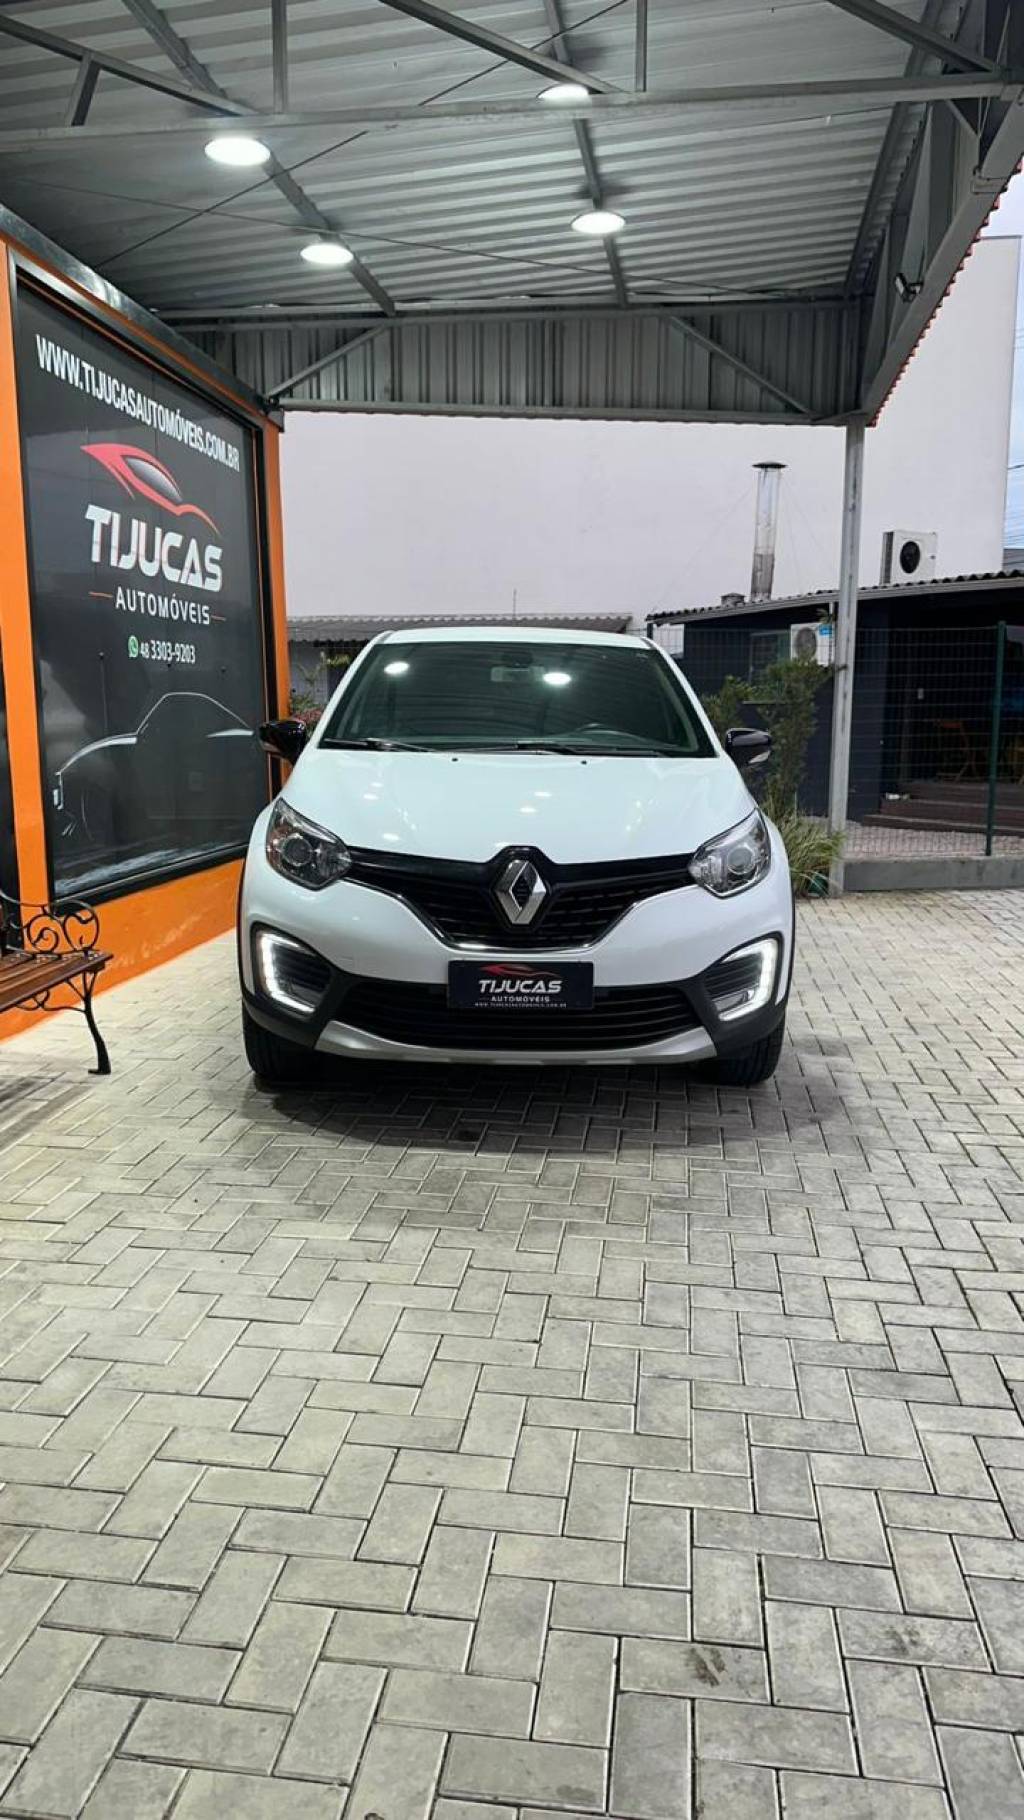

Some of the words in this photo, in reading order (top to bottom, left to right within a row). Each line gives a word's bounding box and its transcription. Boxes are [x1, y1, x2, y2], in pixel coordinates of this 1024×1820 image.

[36, 334, 240, 472] WWW.TIJUCASAUTOMÓVEIS.COM.BR
[85, 504, 223, 593] TIJUCAS
[115, 586, 210, 625] AUTOMÓVEIS
[150, 639, 196, 664] 3303-9203
[478, 979, 563, 994] TIJUCAS
